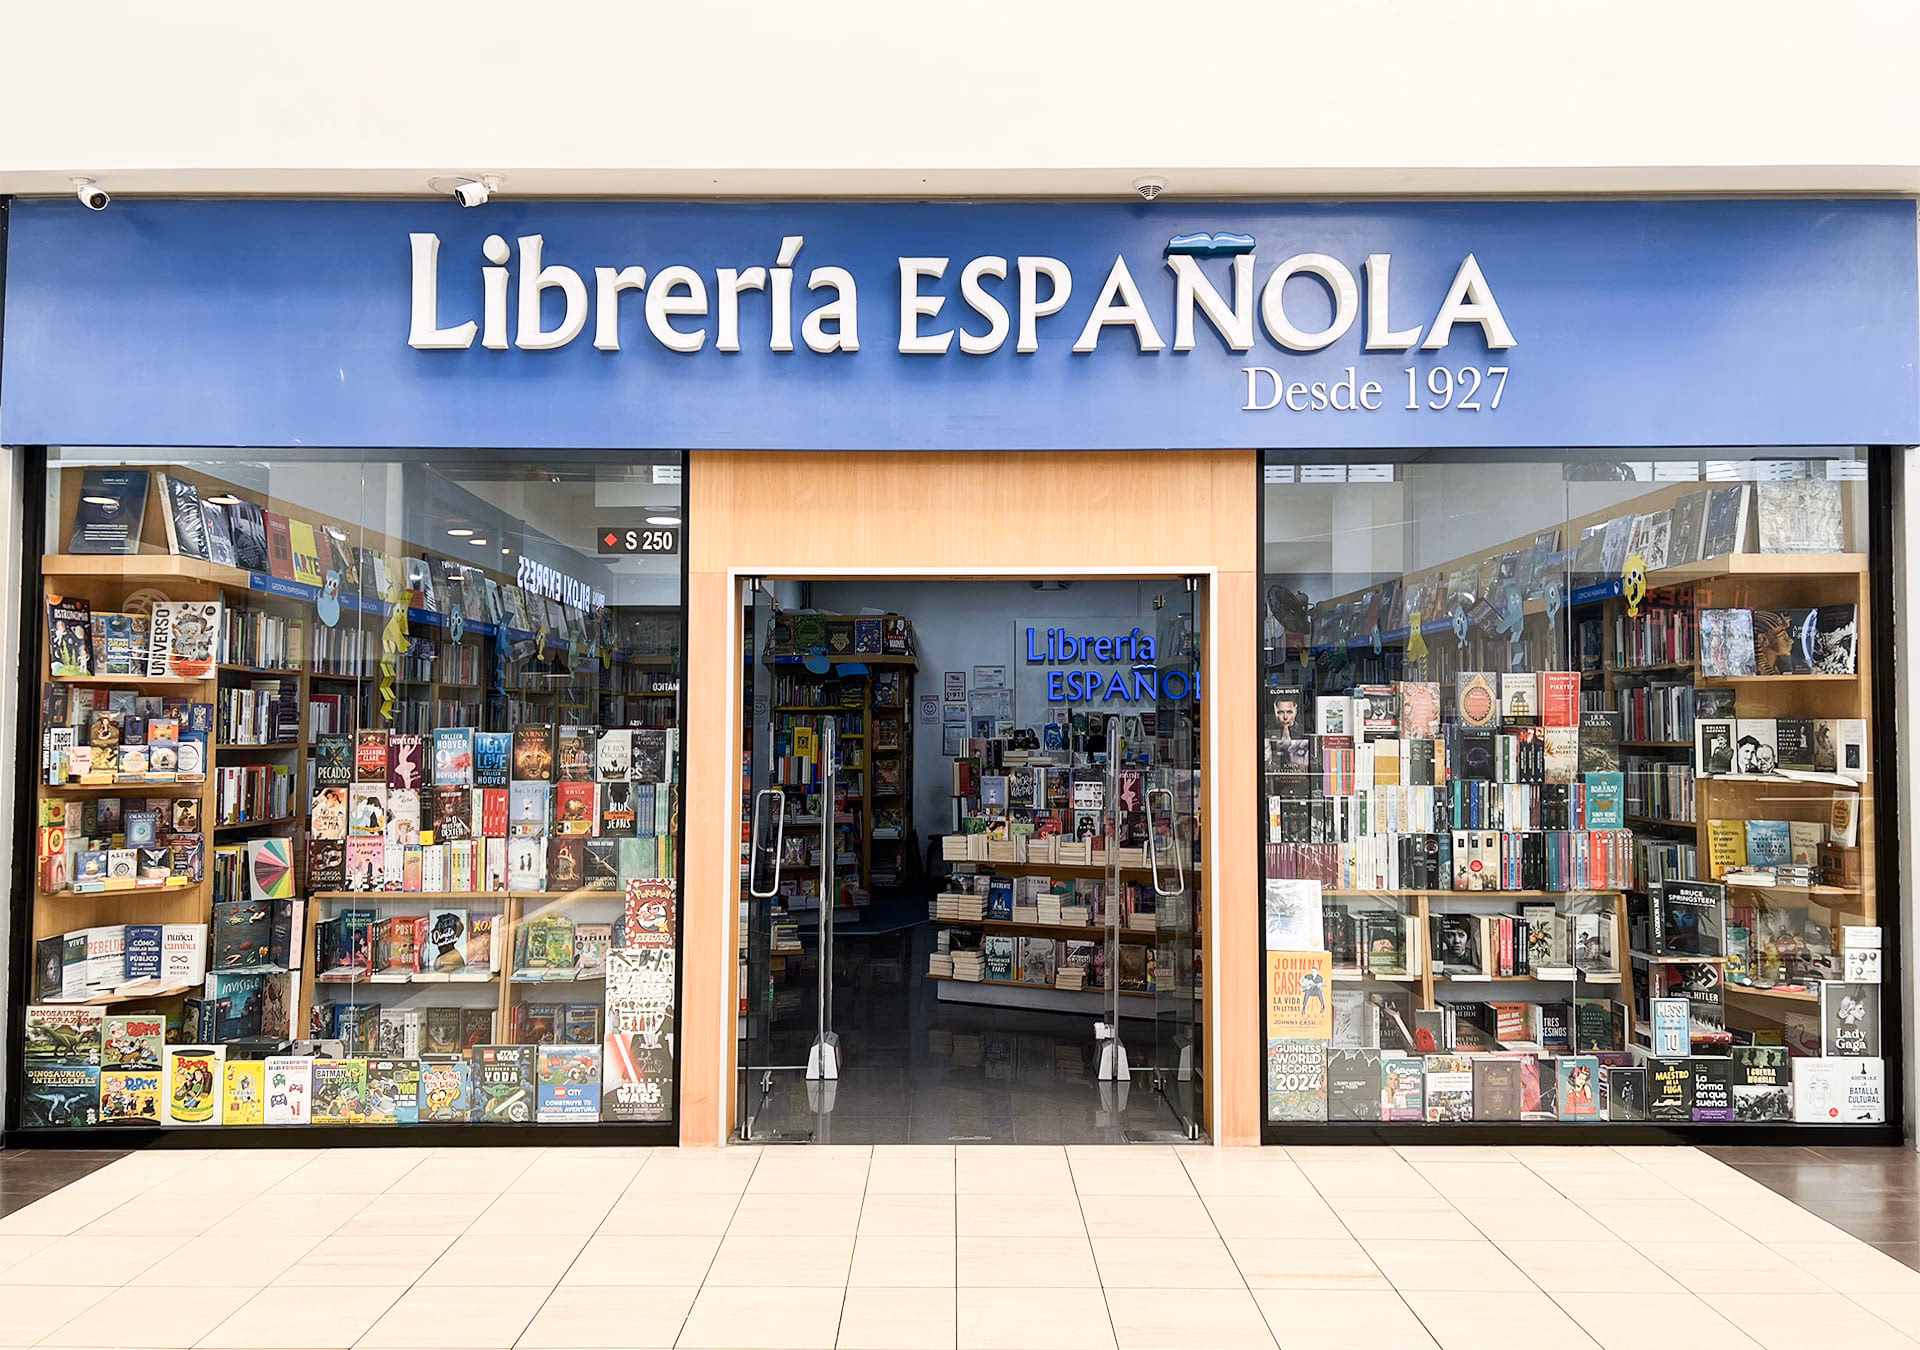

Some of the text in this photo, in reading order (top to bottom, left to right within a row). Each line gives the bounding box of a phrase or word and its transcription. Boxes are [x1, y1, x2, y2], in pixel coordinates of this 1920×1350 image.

[408, 232, 1518, 354] Librería ESPAÑOLA
[1242, 366, 1510, 411] Desde 1927
[625, 531, 673, 550] S 250
[294, 552, 321, 576] ARTE
[151, 608, 170, 676] UNIVERSO
[1026, 627, 1157, 661] Librería
[1584, 719, 1612, 727] TOLKIEN
[54, 732, 72, 743] TAROT
[437, 740, 468, 749] HOOVER
[478, 739, 508, 753] UGLY
[478, 754, 507, 769] LOVE
[318, 767, 351, 779] PECADOS
[478, 776, 506, 784] HOOVER
[609, 801, 630, 812] BLUE
[607, 819, 631, 830] JEANS
[1680, 889, 1704, 897] BRUCE
[1668, 894, 1715, 904] SPRINGSTEEN
[69, 938, 85, 948] VIVE
[164, 942, 196, 950] cambia
[1274, 959, 1323, 970] JOHNNY
[222, 977, 259, 994] INVISIBLE
[1274, 971, 1301, 996] CASH
[1694, 991, 1718, 1002] HITLER
[1657, 1003, 1686, 1017] MESSI
[1543, 1018, 1559, 1027] TRES
[1836, 1028, 1866, 1041] Lady
[1665, 1033, 1680, 1051] 10
[1835, 1039, 1866, 1051] Gaga
[1276, 1045, 1321, 1053] GUINNESS
[1275, 1054, 1321, 1064] WORLD
[28, 1070, 87, 1078] DINOSAURIOS
[316, 1069, 346, 1078] BATMAN
[1276, 1065, 1321, 1073] RECORDS
[1751, 1067, 1776, 1075] GUERRA
[485, 1072, 518, 1082] YODA
[1655, 1071, 1689, 1080] MAESTRO
[1695, 1074, 1707, 1082] La
[1747, 1075, 1776, 1084] MUNDIAL
[1276, 1074, 1321, 1091] 2024
[1695, 1082, 1723, 1091] forma
[622, 1083, 659, 1094] STAR
[1663, 1085, 1682, 1094] FUGA
[1849, 1087, 1879, 1095] BATALLA
[617, 1092, 661, 1104] WARS
[1710, 1092, 1727, 1100] que
